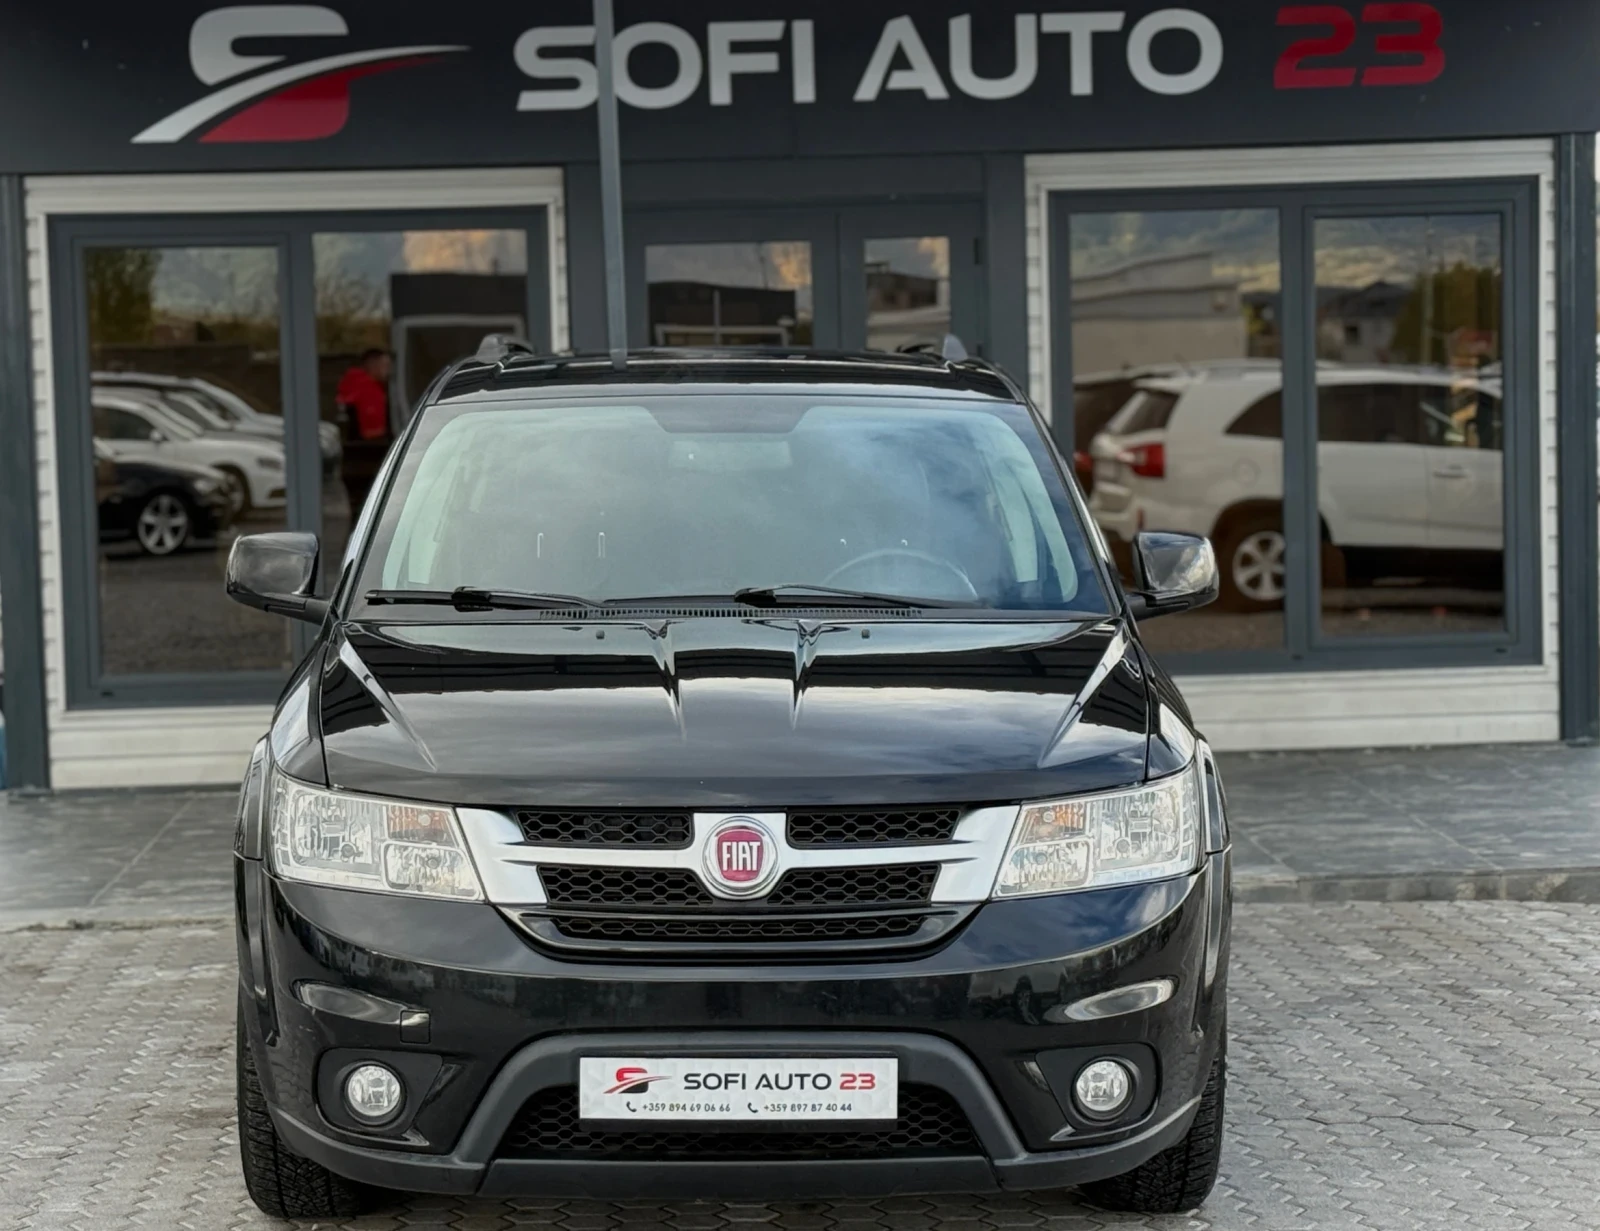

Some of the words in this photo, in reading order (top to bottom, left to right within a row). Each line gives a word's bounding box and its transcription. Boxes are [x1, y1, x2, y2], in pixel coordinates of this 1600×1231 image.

[513, 19, 816, 112] SOFI
[853, 8, 1223, 101] AUTO
[1273, 3, 1446, 89] 23
[722, 841, 761, 871] FIAT
[683, 1072, 747, 1091] SOFI
[754, 1072, 833, 1091] AUTO
[839, 1072, 876, 1091] 23
[642, 1102, 667, 1112] +359
[668, 1102, 687, 1112] 894
[689, 1102, 701, 1112] 69
[704, 1102, 716, 1112] 06
[719, 1102, 731, 1112] 66
[763, 1103, 788, 1113] +359
[790, 1103, 808, 1113] 897
[810, 1103, 823, 1113] 87
[825, 1103, 838, 1113] 40
[839, 1103, 852, 1112] 44
